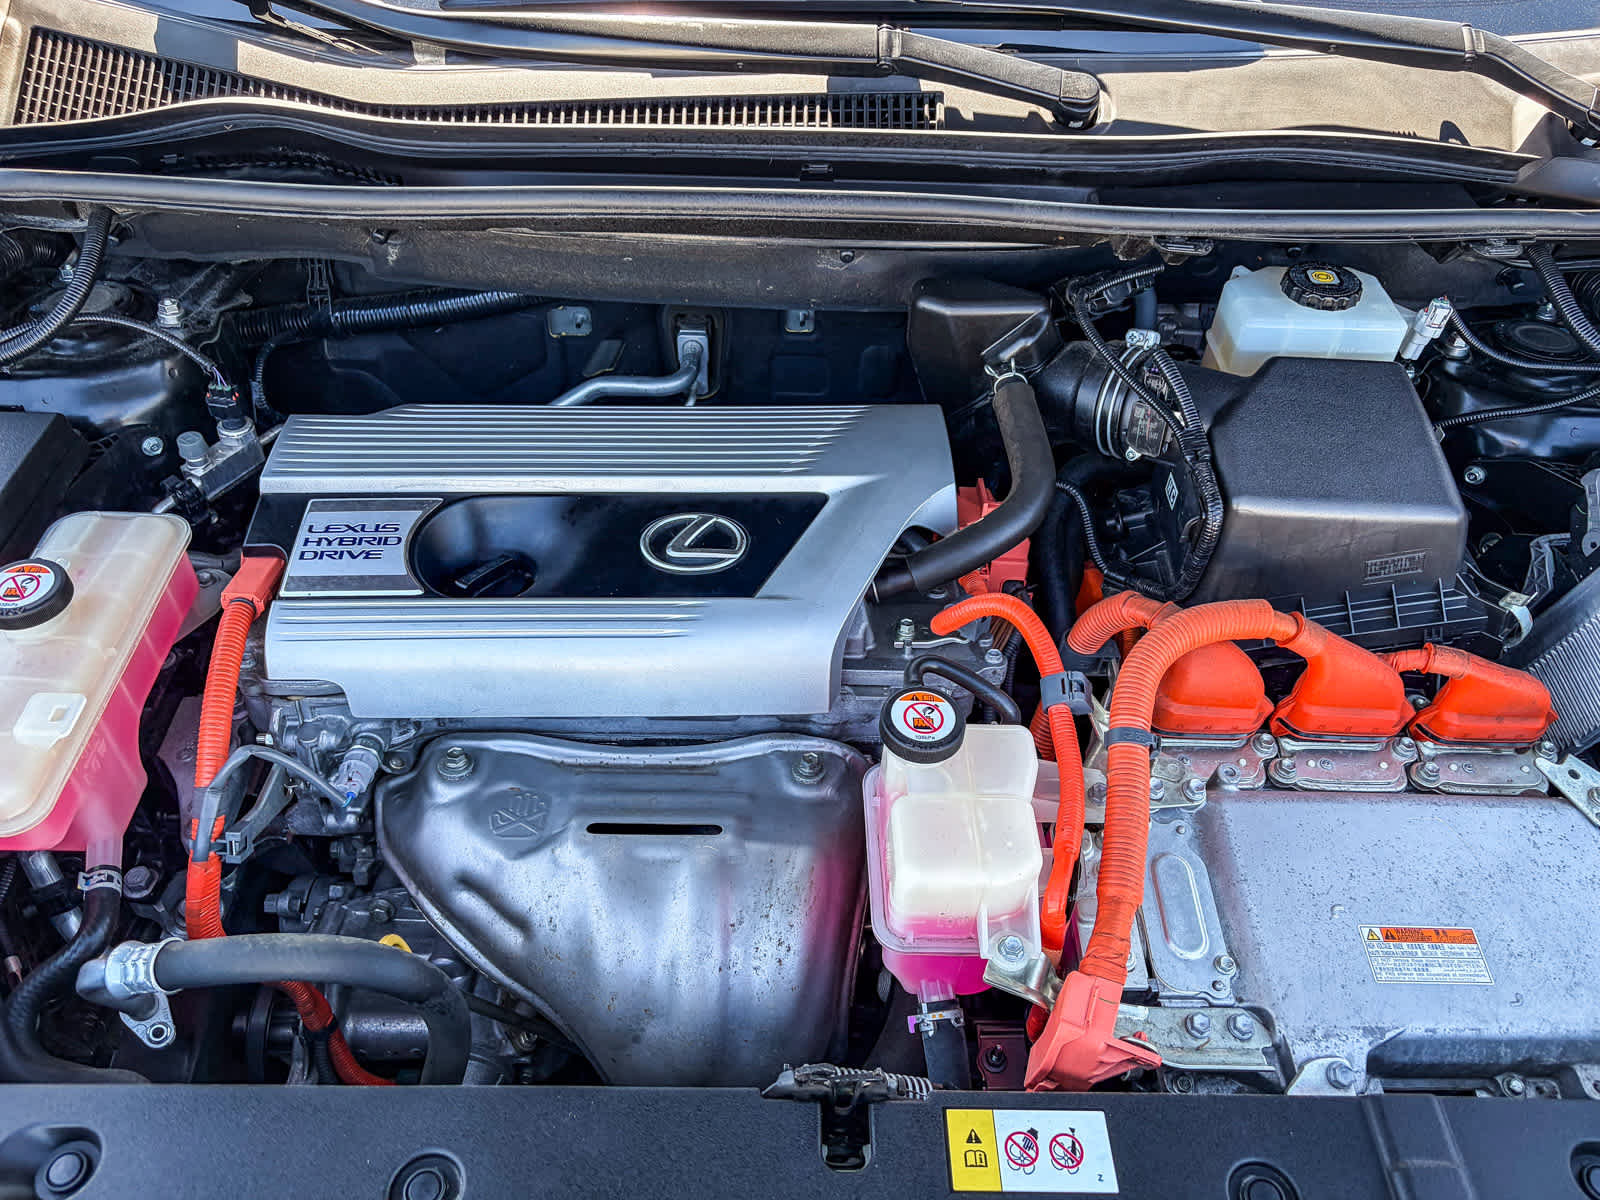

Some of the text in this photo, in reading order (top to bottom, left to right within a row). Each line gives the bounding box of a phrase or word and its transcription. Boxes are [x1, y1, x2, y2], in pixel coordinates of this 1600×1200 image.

[307, 523, 401, 533] LEXUS
[302, 536, 403, 547] HYBRID
[298, 549, 385, 561] DRIVE
